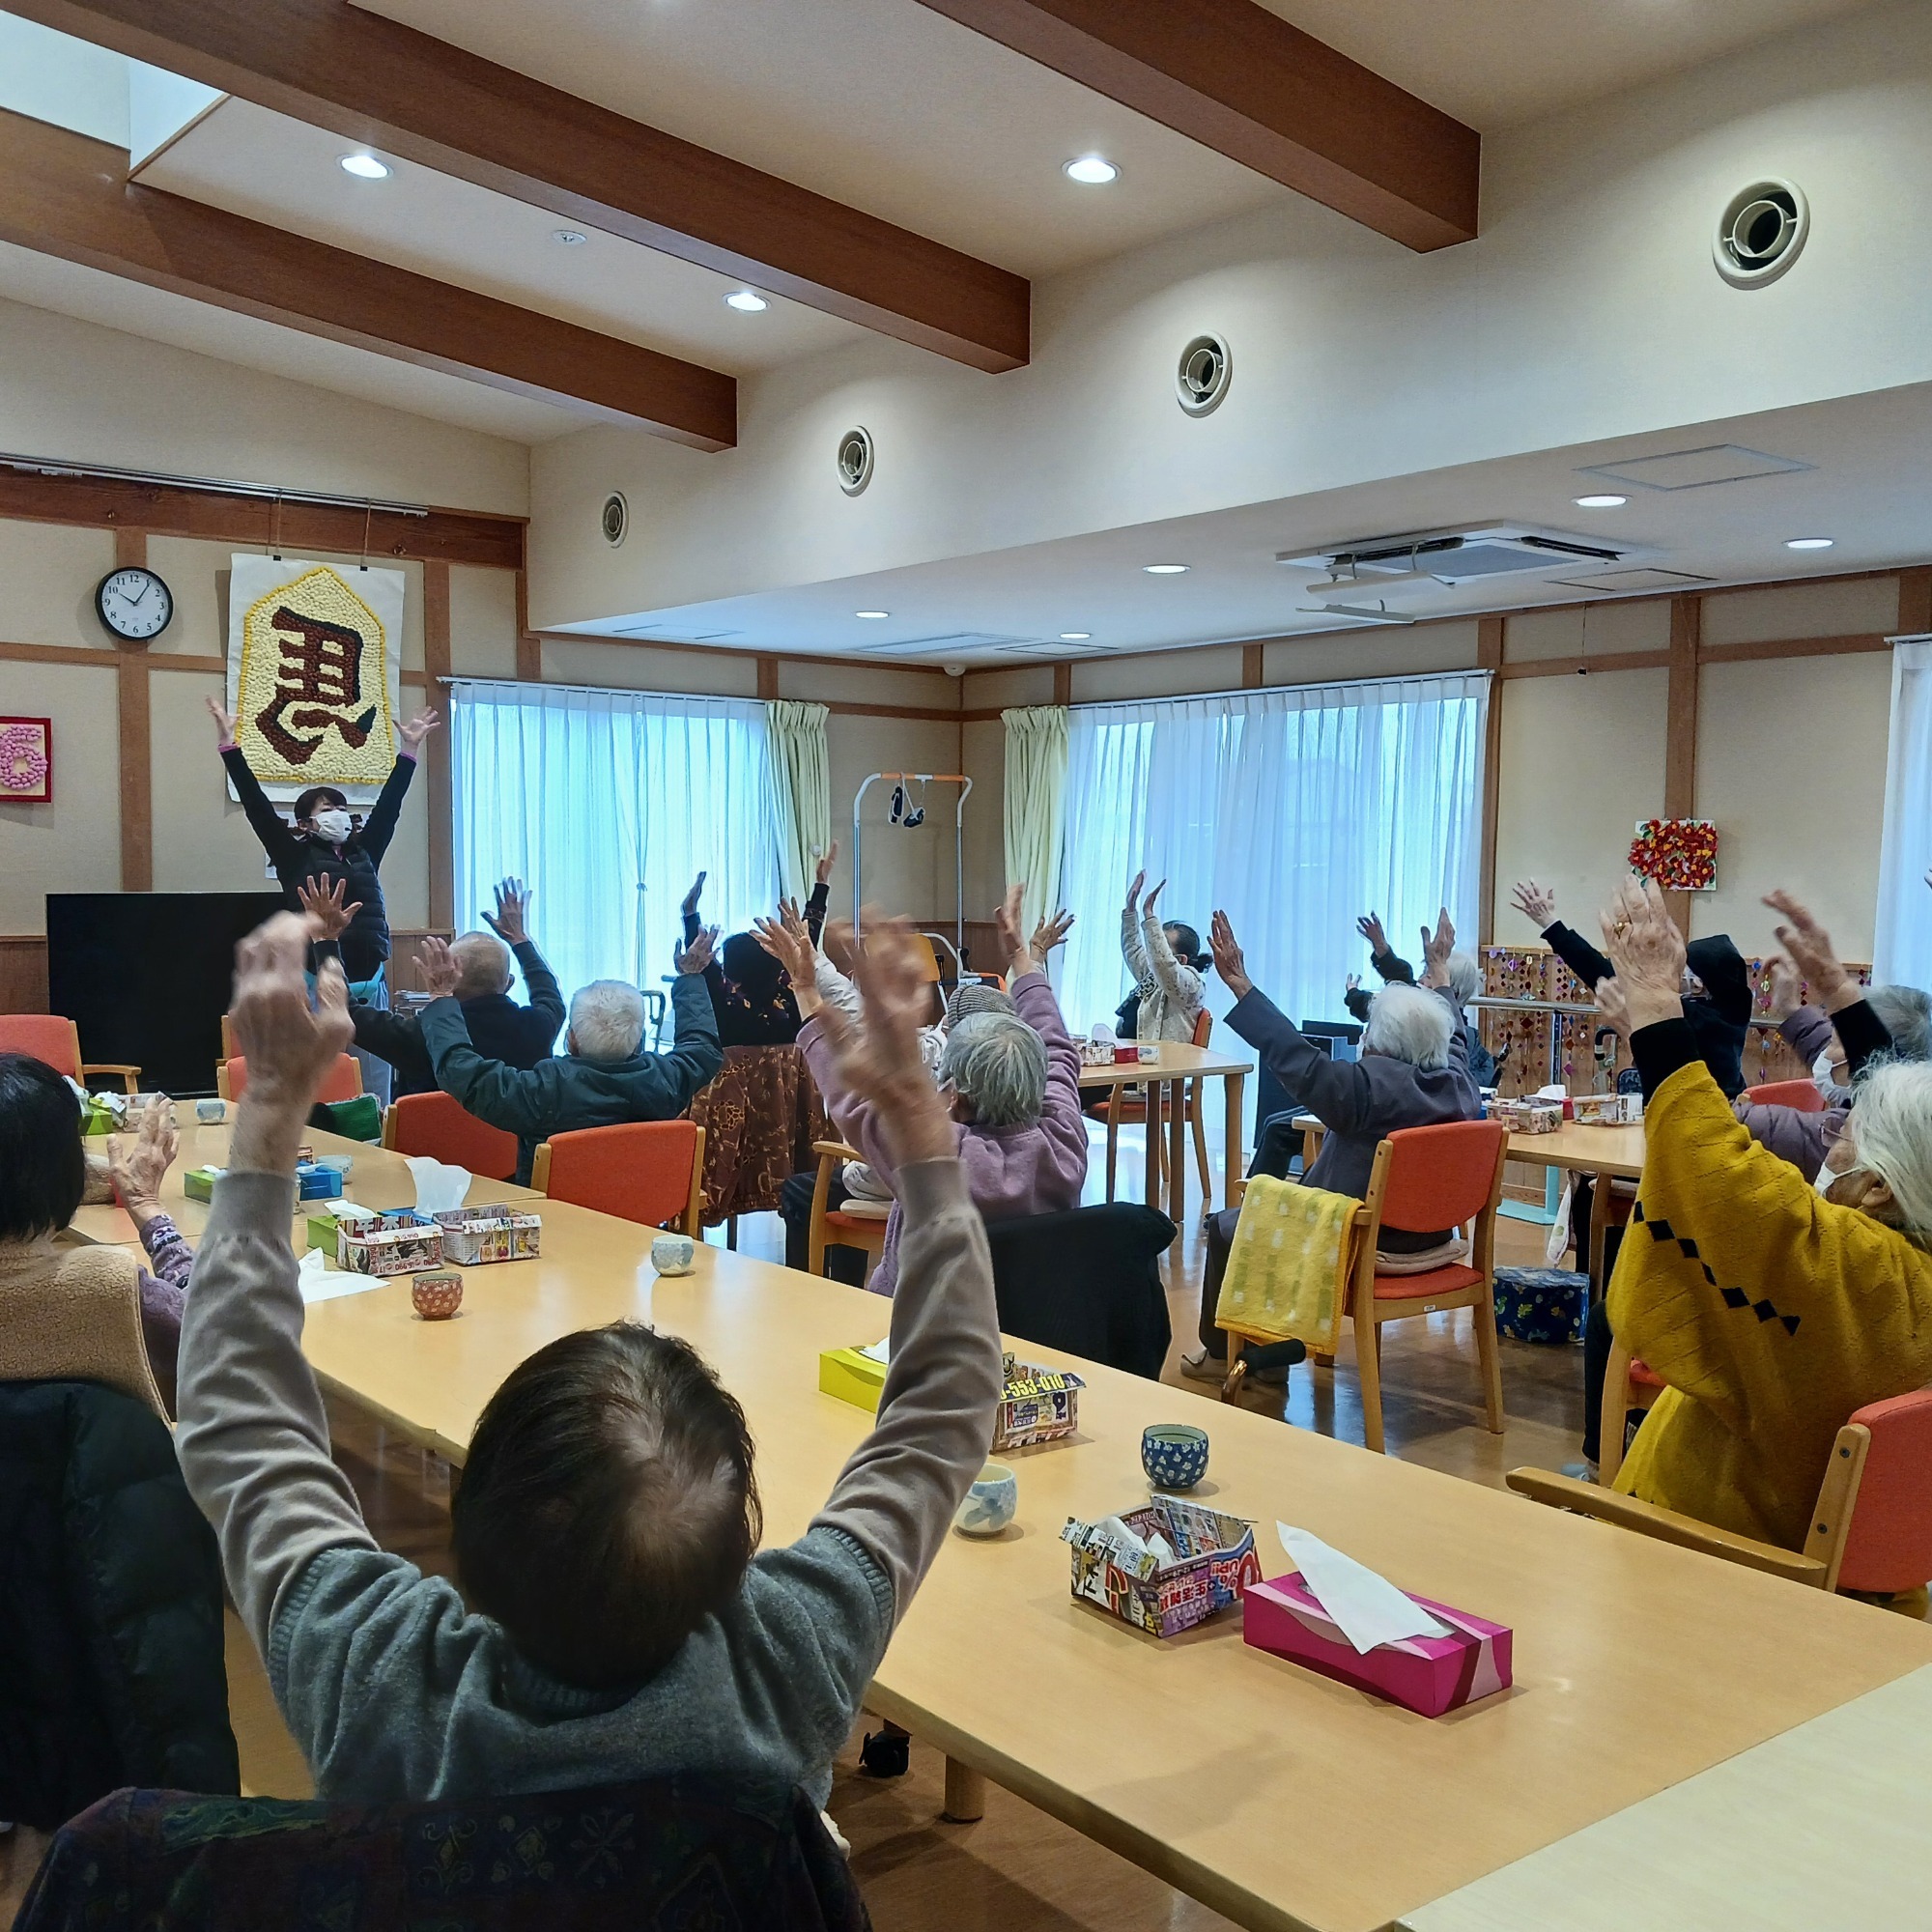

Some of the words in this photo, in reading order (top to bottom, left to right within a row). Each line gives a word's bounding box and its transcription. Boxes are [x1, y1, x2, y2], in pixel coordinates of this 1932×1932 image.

[129, 574, 140, 583] 12
[108, 585, 118, 594] 10
[110, 611, 117, 619] 8
